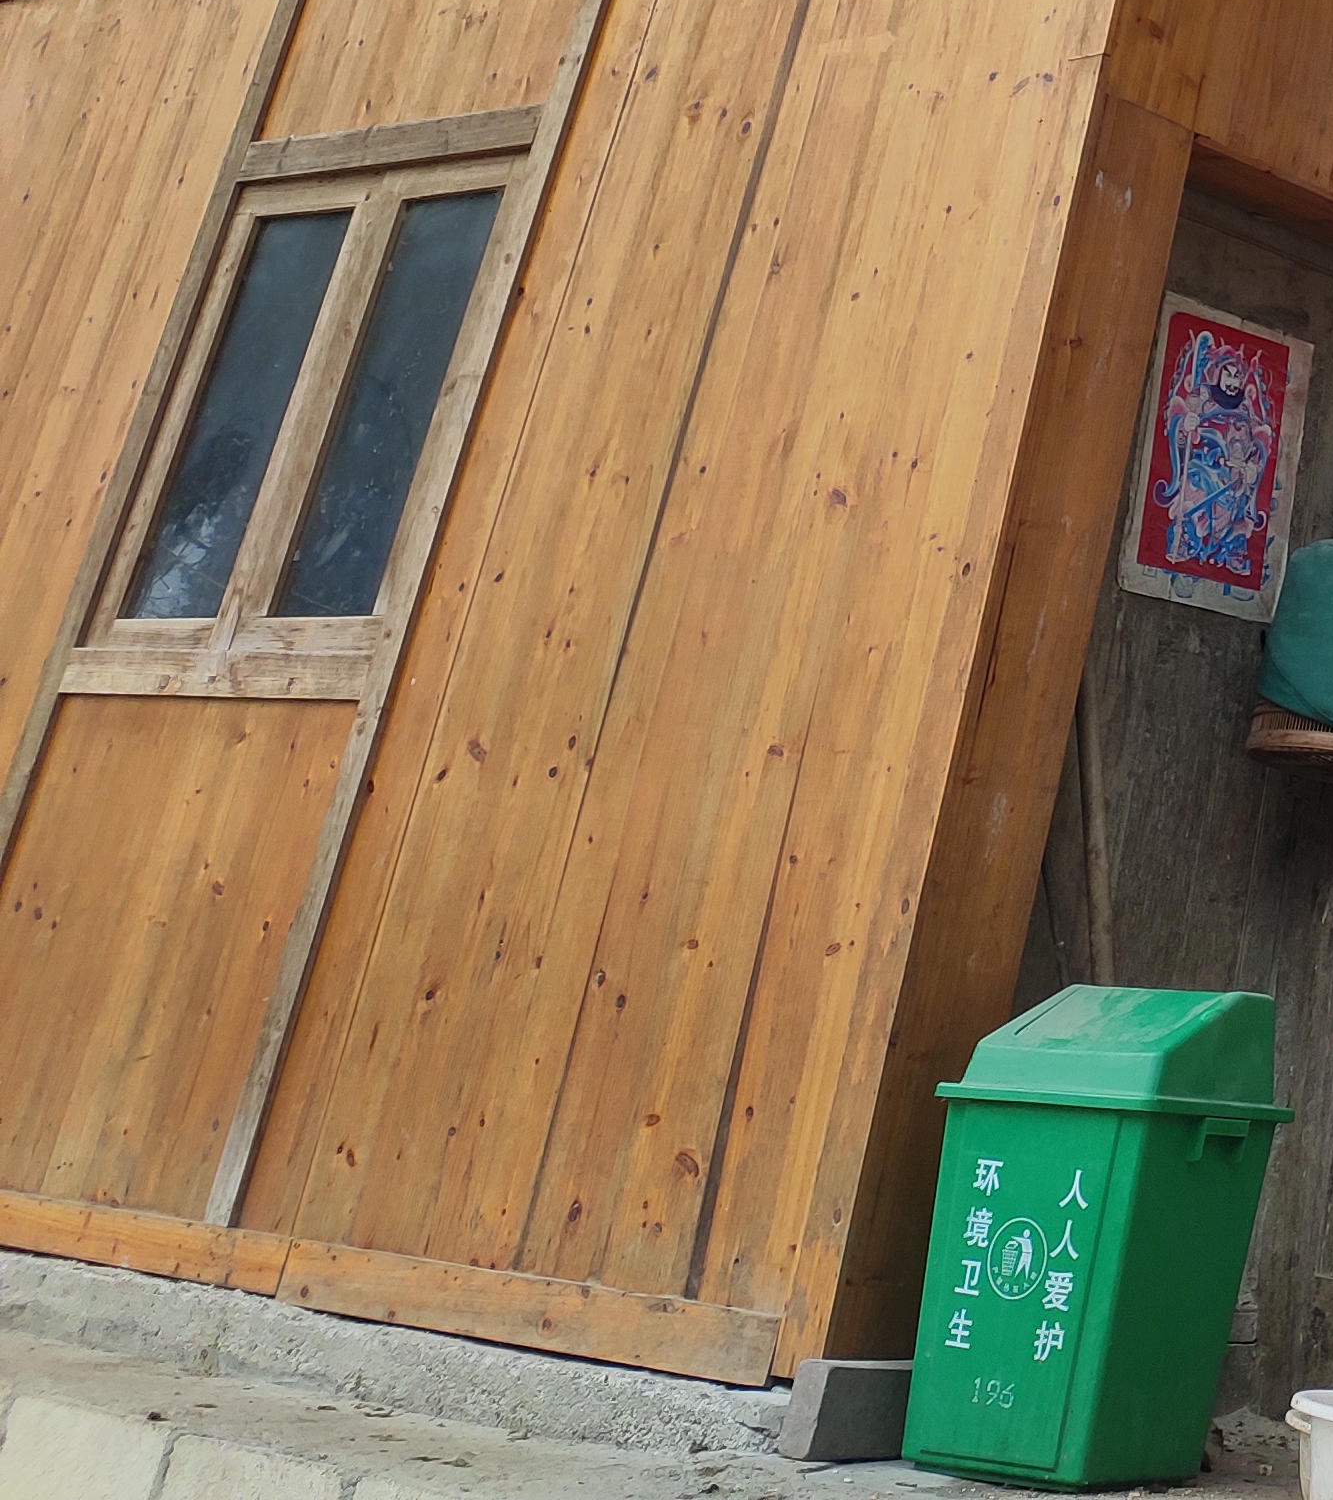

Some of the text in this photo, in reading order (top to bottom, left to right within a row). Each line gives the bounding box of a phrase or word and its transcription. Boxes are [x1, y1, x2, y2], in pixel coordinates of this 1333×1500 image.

[944, 1157, 1004, 1350] 环境卫生
[1033, 1168, 1089, 1363] 人人爱护
